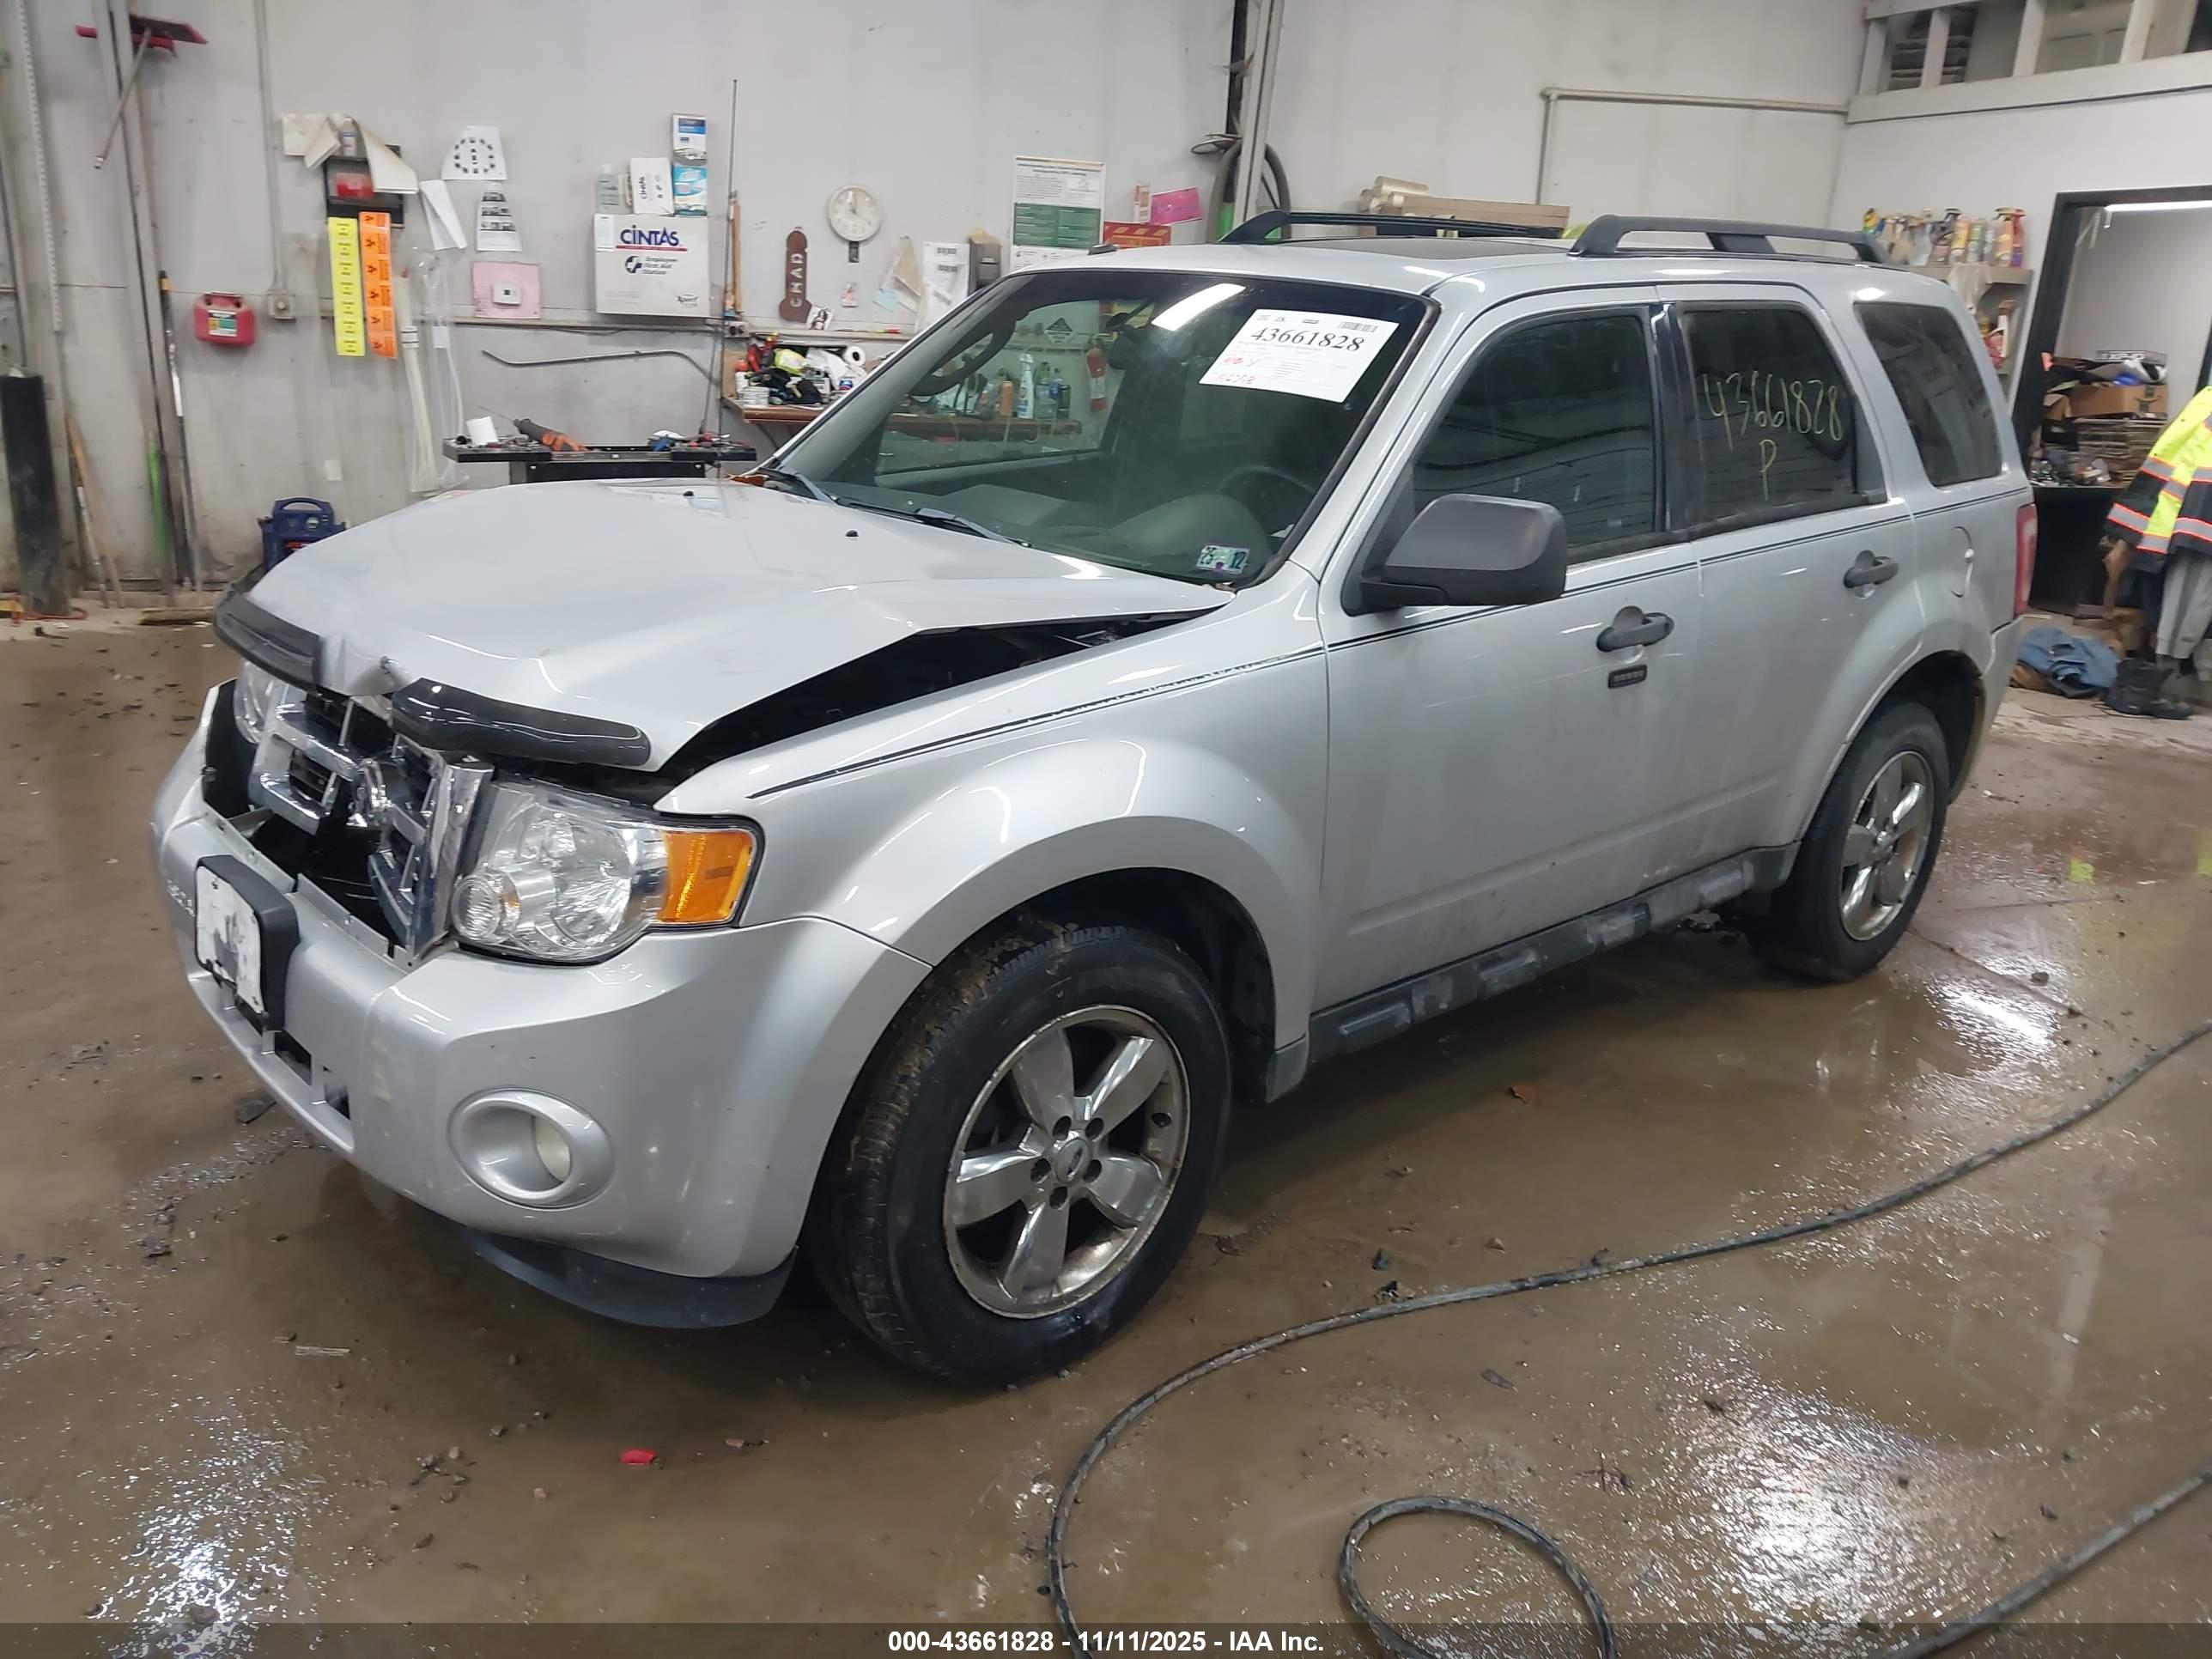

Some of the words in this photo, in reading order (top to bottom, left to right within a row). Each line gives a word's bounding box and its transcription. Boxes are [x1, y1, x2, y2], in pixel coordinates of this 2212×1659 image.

[620, 224, 679, 246] CINTAS
[789, 252, 804, 307] CHAD
[1250, 327, 1365, 352] 43661828
[1702, 370, 1843, 453] 43661828
[1759, 439, 1777, 501] P
